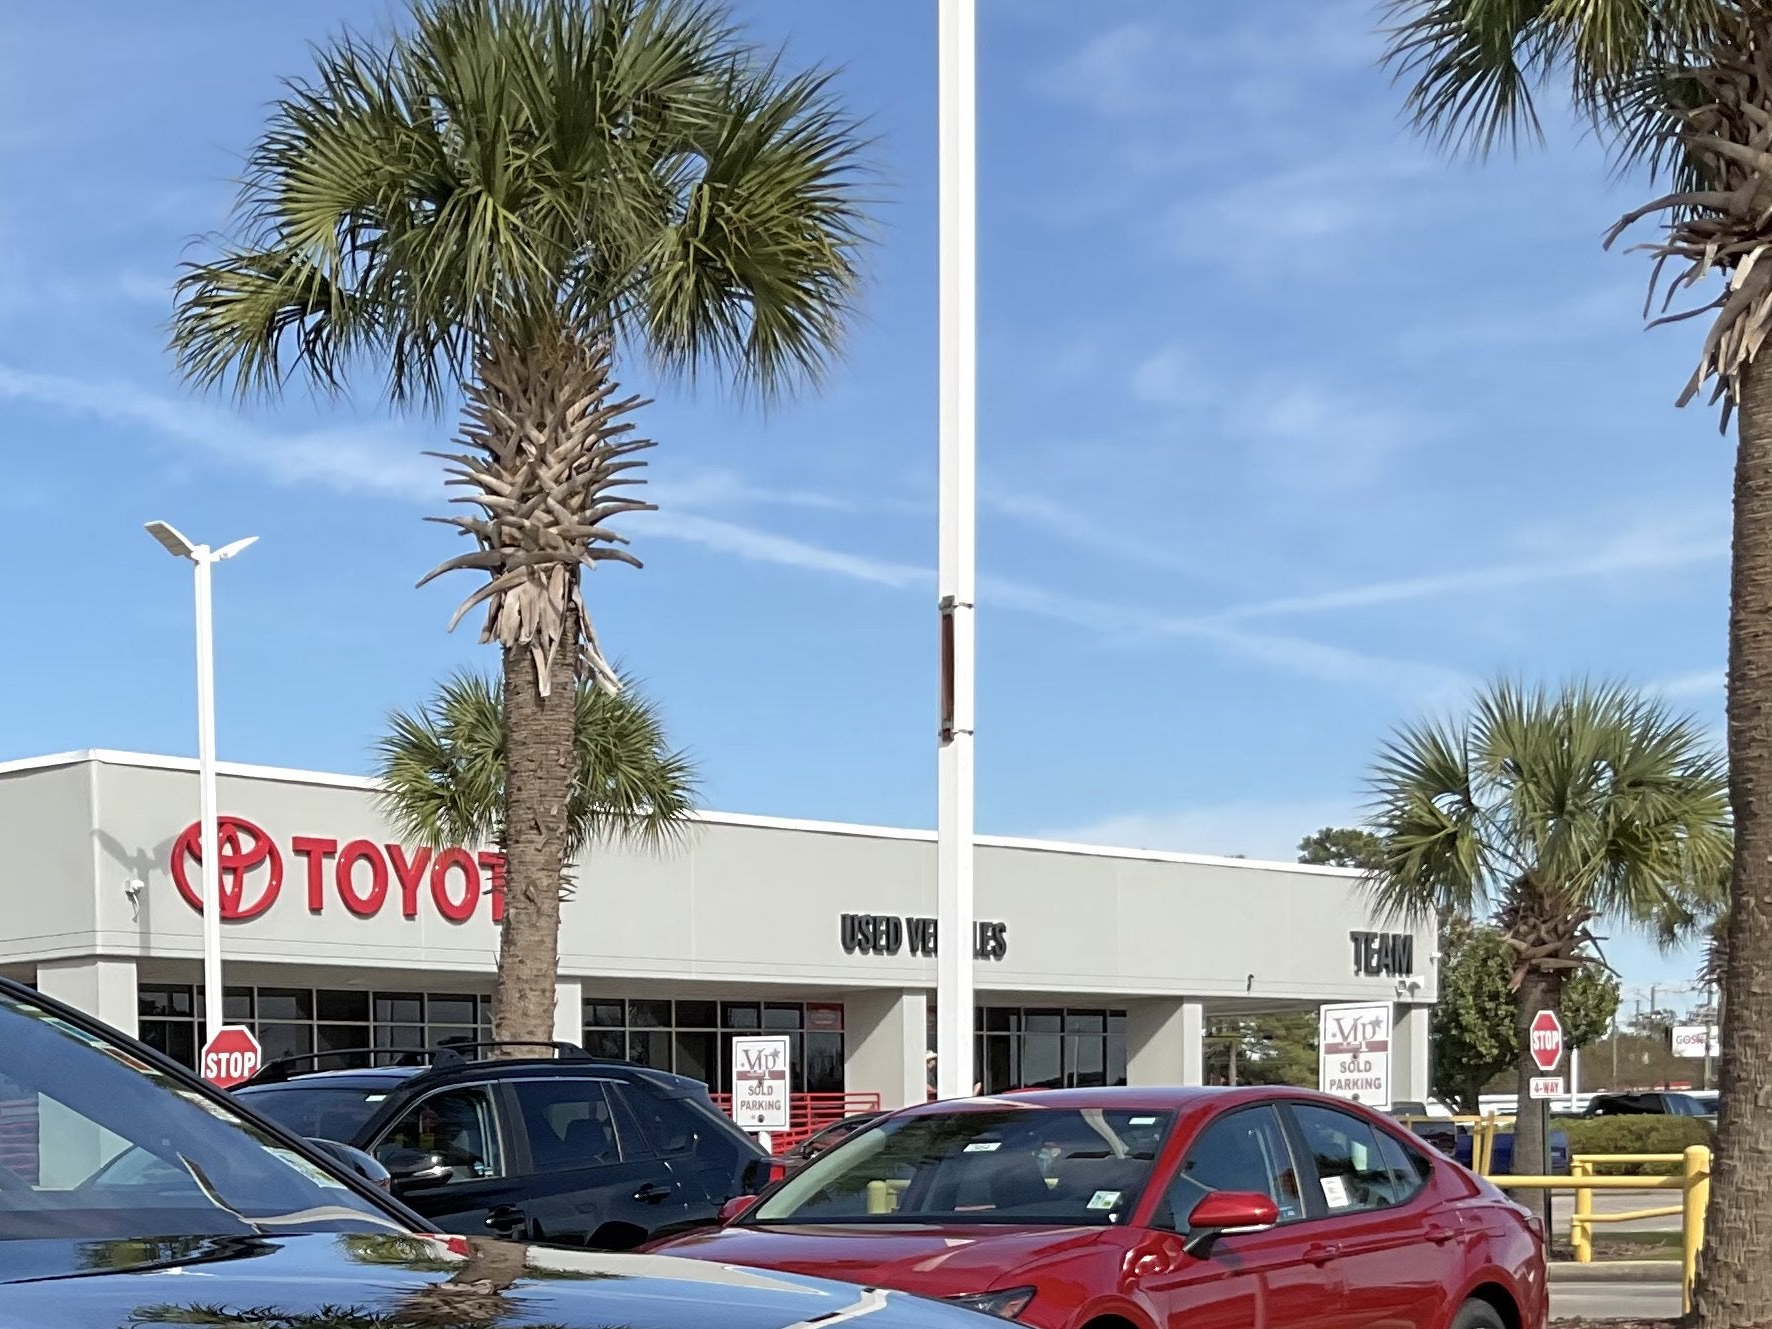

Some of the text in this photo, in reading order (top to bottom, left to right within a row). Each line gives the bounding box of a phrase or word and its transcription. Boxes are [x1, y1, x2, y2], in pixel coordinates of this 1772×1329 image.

[292, 836, 506, 922] TOYOT
[840, 914, 1008, 961] USED VELES
[1349, 931, 1413, 977] TEAM
[1532, 1030, 1559, 1051] STOP
[206, 1051, 256, 1079] STOP
[1339, 1060, 1372, 1074] SOLD
[747, 1085, 774, 1096] SOLD
[1329, 1077, 1382, 1091] PARKING
[1533, 1081, 1560, 1094] 4-WAY
[740, 1100, 781, 1111] PARKING
